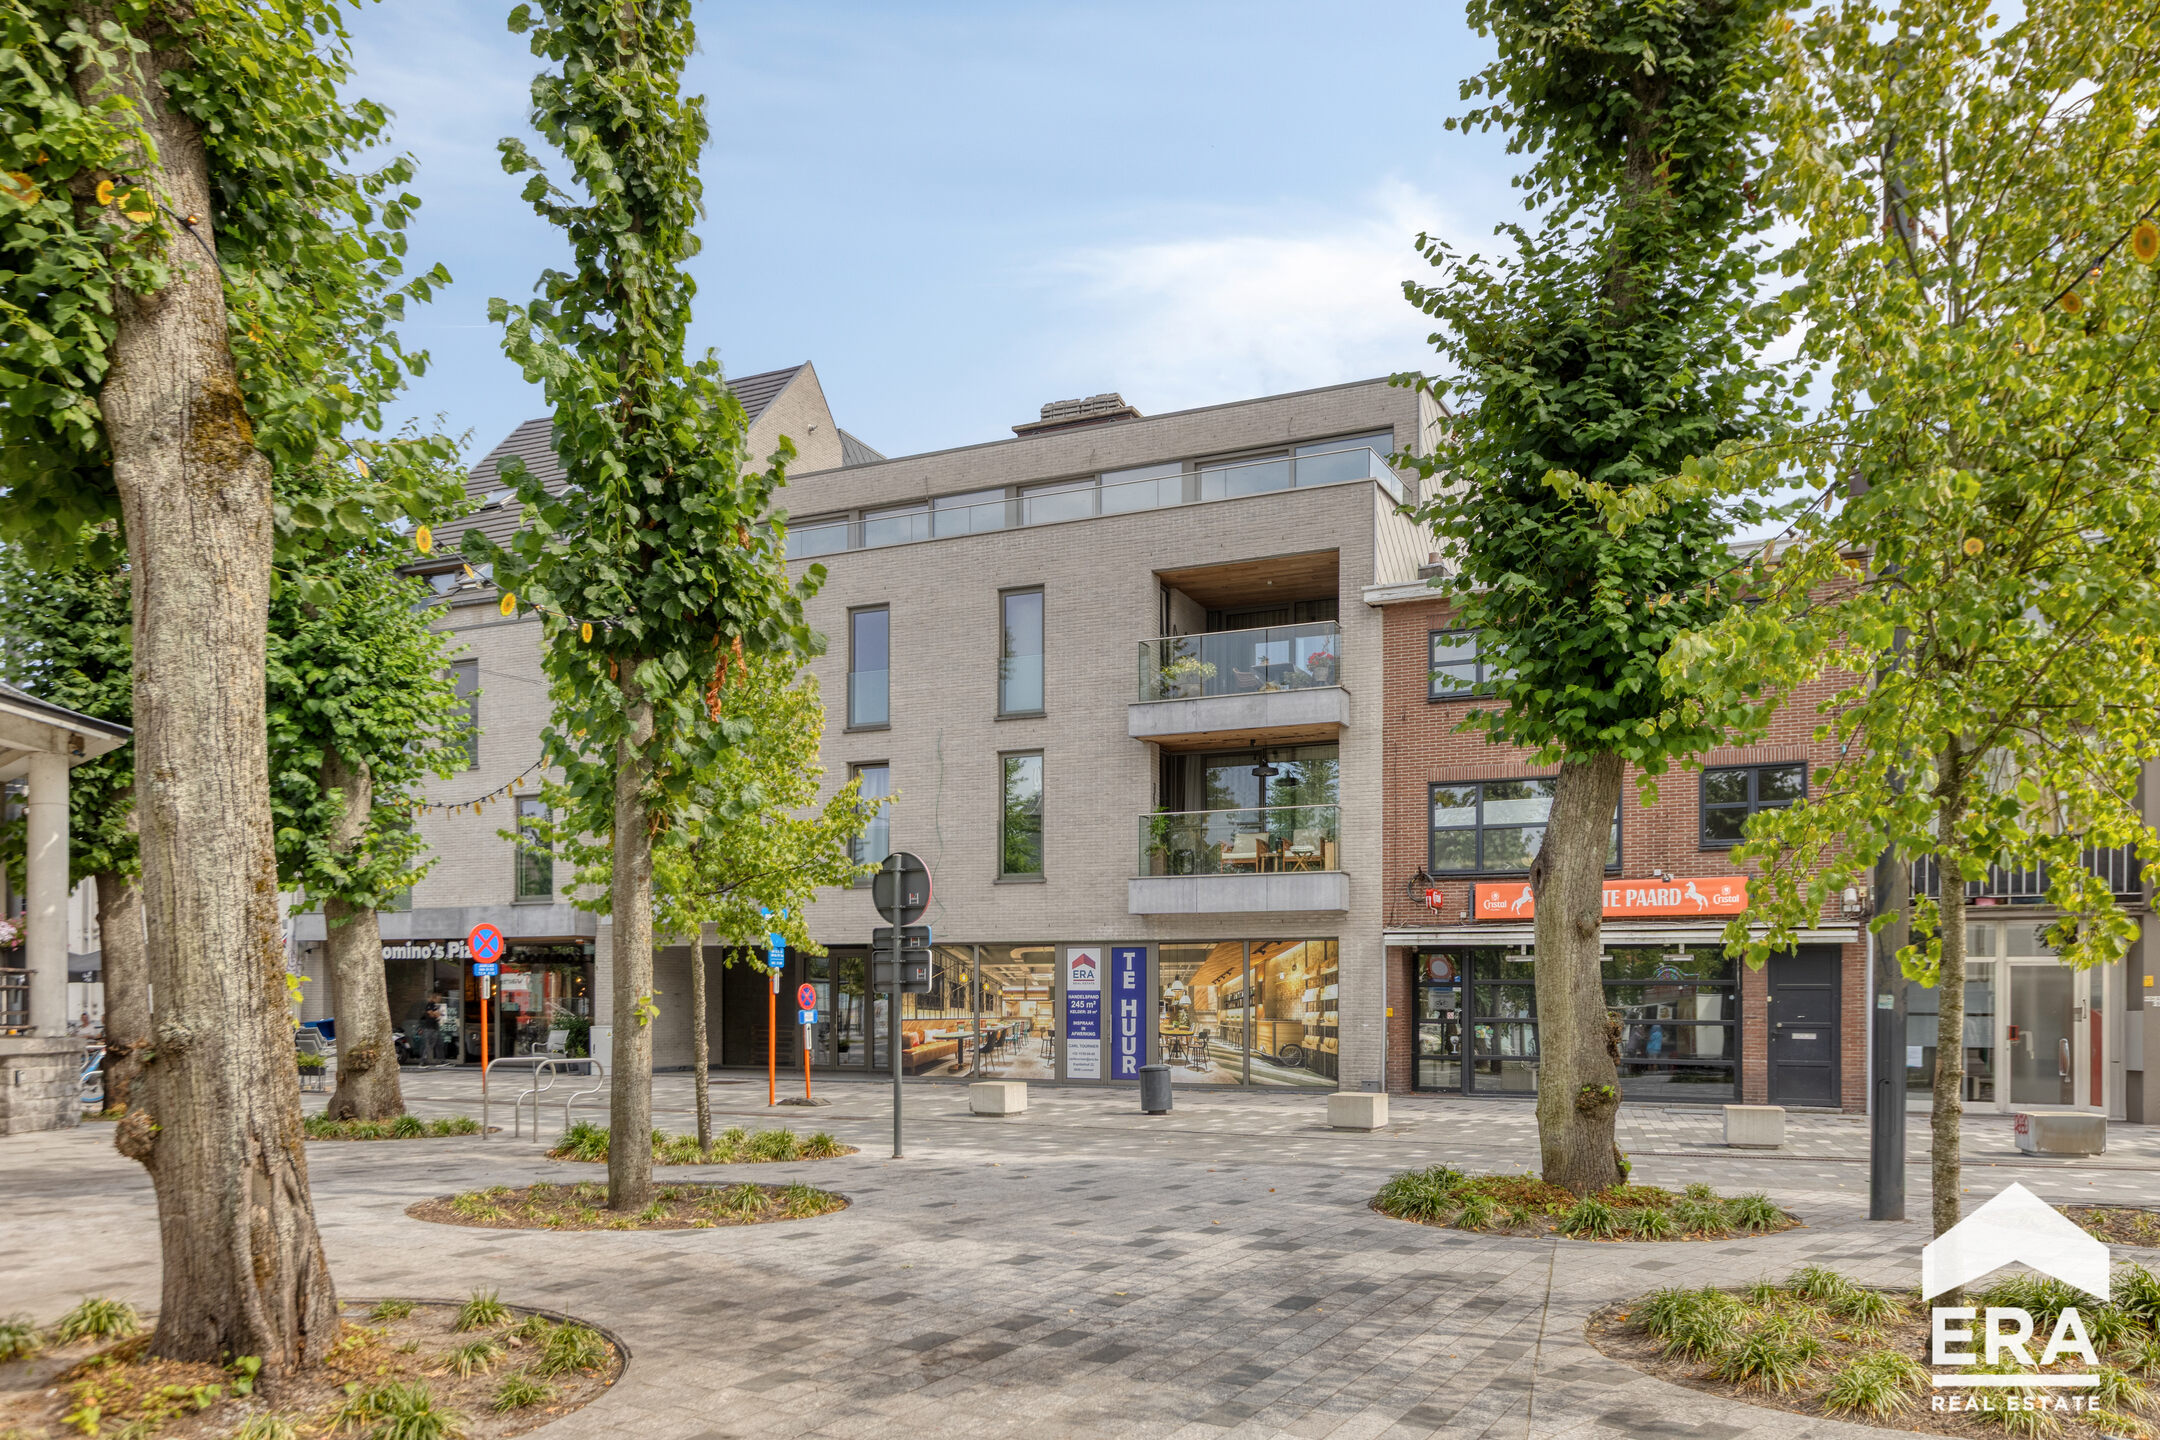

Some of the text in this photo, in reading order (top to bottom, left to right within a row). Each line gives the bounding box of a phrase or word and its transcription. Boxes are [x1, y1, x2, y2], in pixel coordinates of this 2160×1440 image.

[1602, 888, 1682, 908] TE PAARD
[1713, 894, 1740, 905] Cristal
[1483, 899, 1507, 910] Cristal
[382, 940, 445, 959] omino's
[1073, 970, 1094, 979] ERA
[1070, 1000, 1085, 1008] 245
[1121, 952, 1137, 1074] TE HUUR
